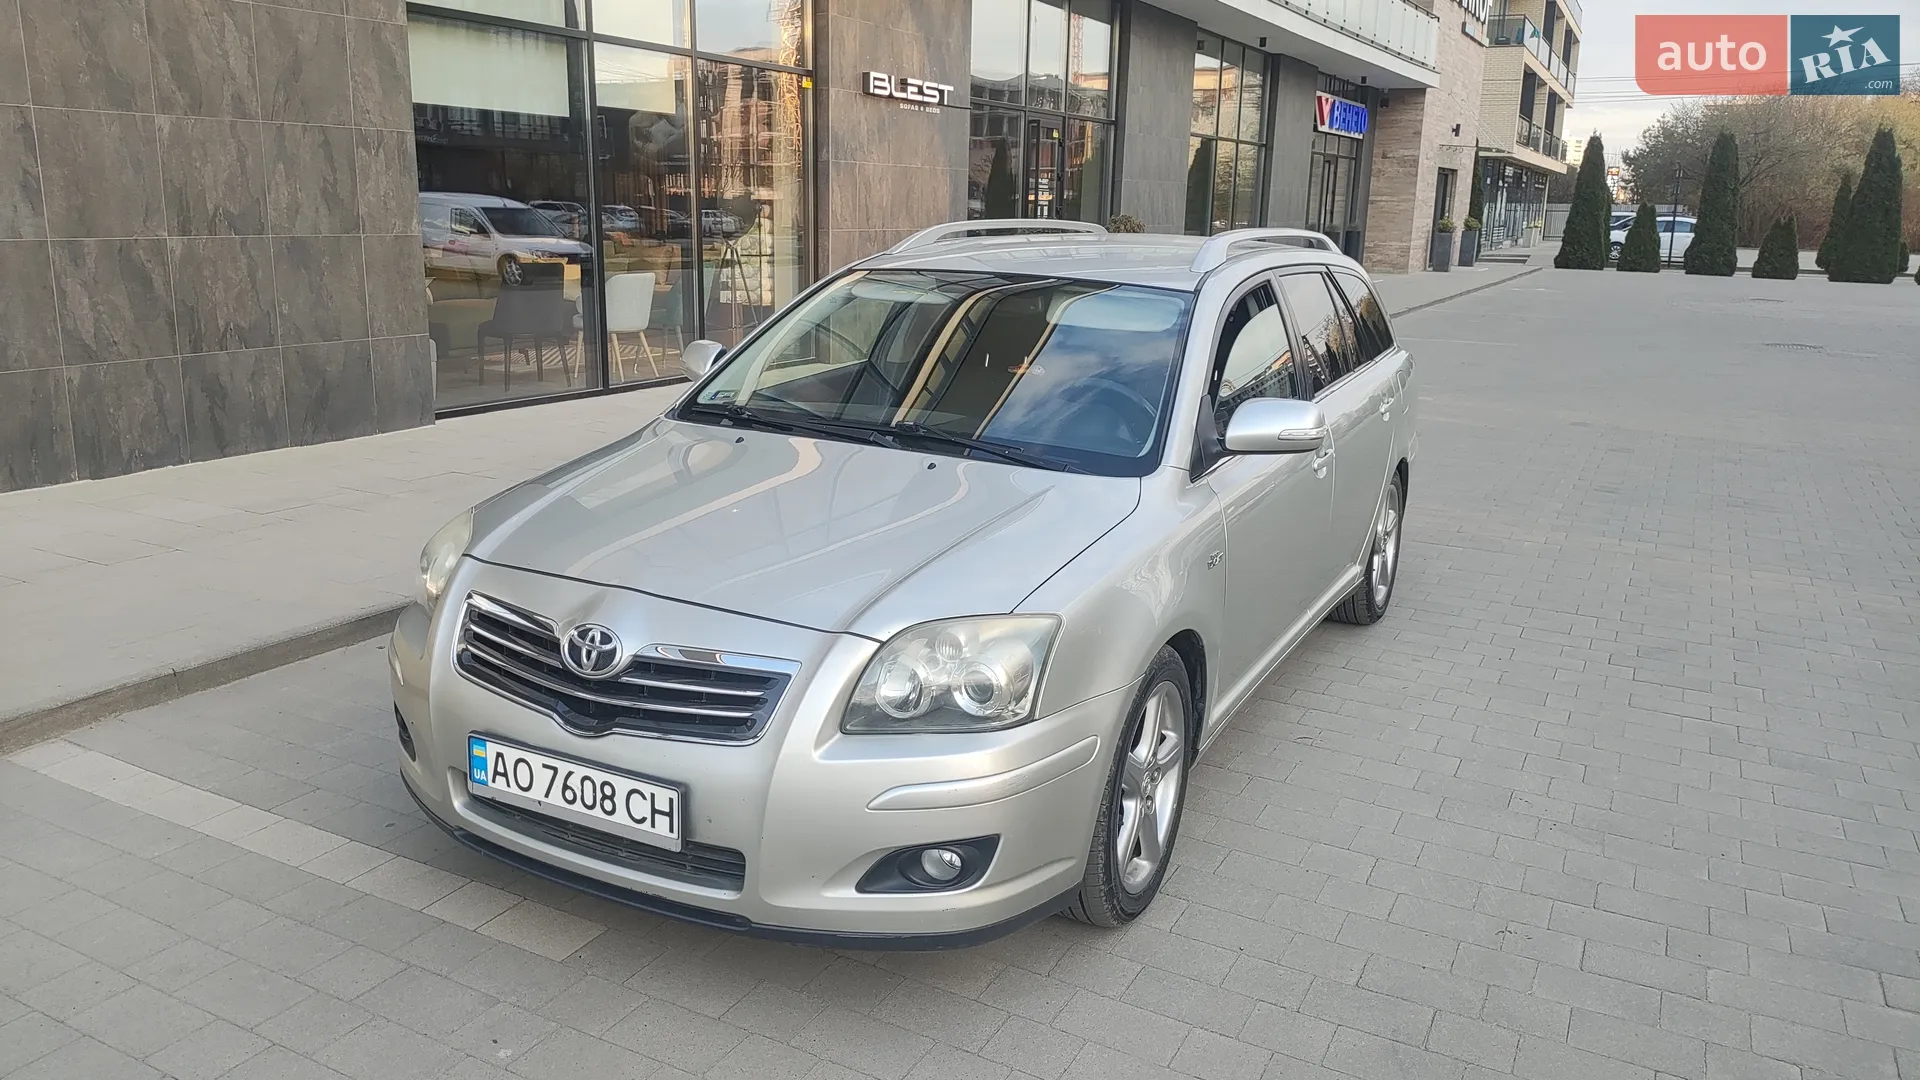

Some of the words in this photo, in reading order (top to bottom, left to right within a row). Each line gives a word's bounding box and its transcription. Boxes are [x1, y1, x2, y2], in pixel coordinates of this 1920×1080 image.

[868, 71, 954, 105] BLEST
[899, 103, 919, 111] SOFAS
[474, 768, 487, 781] UA
[491, 751, 534, 793] AO
[541, 763, 617, 817] 7608
[625, 788, 674, 834] CH
